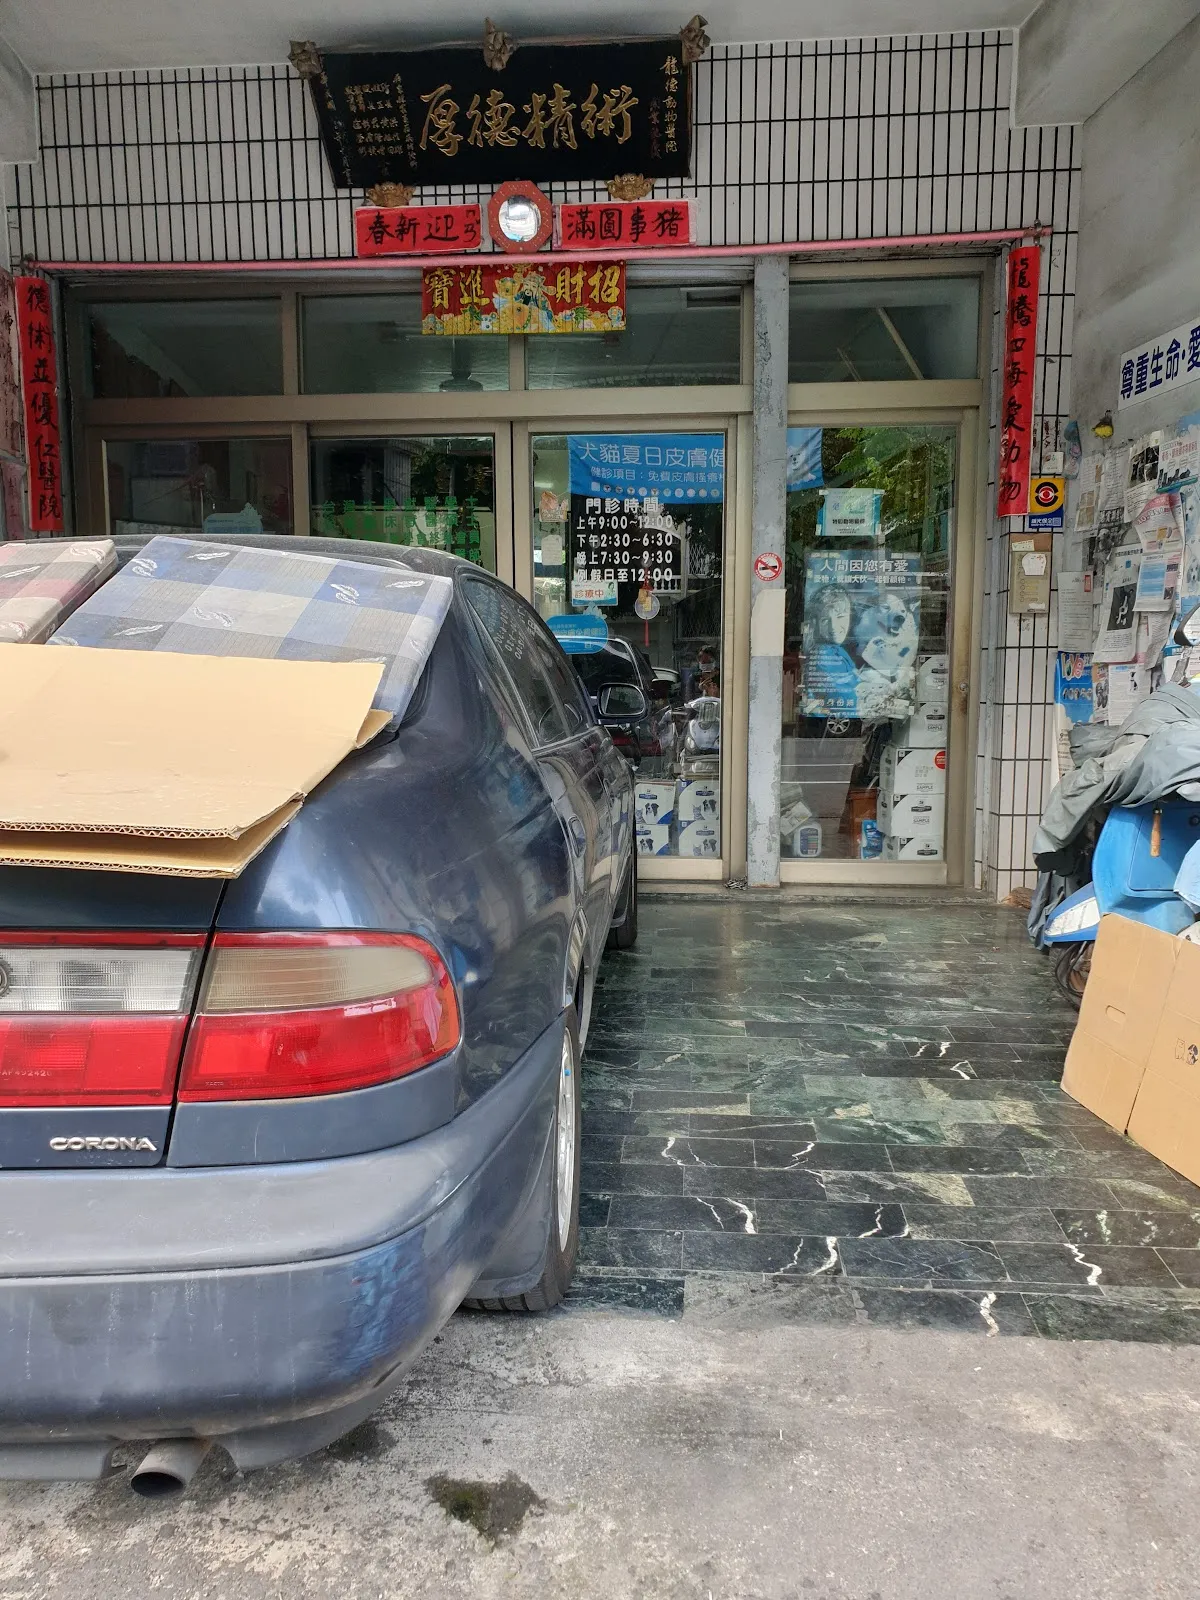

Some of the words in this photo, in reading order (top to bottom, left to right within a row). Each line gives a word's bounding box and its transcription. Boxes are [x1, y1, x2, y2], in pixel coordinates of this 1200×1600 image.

[585, 497, 660, 514] 門診時間
[820, 559, 908, 572] 人間因您有愛
[574, 588, 604, 599] 診療中
[49, 1136, 157, 1152] CORONA
